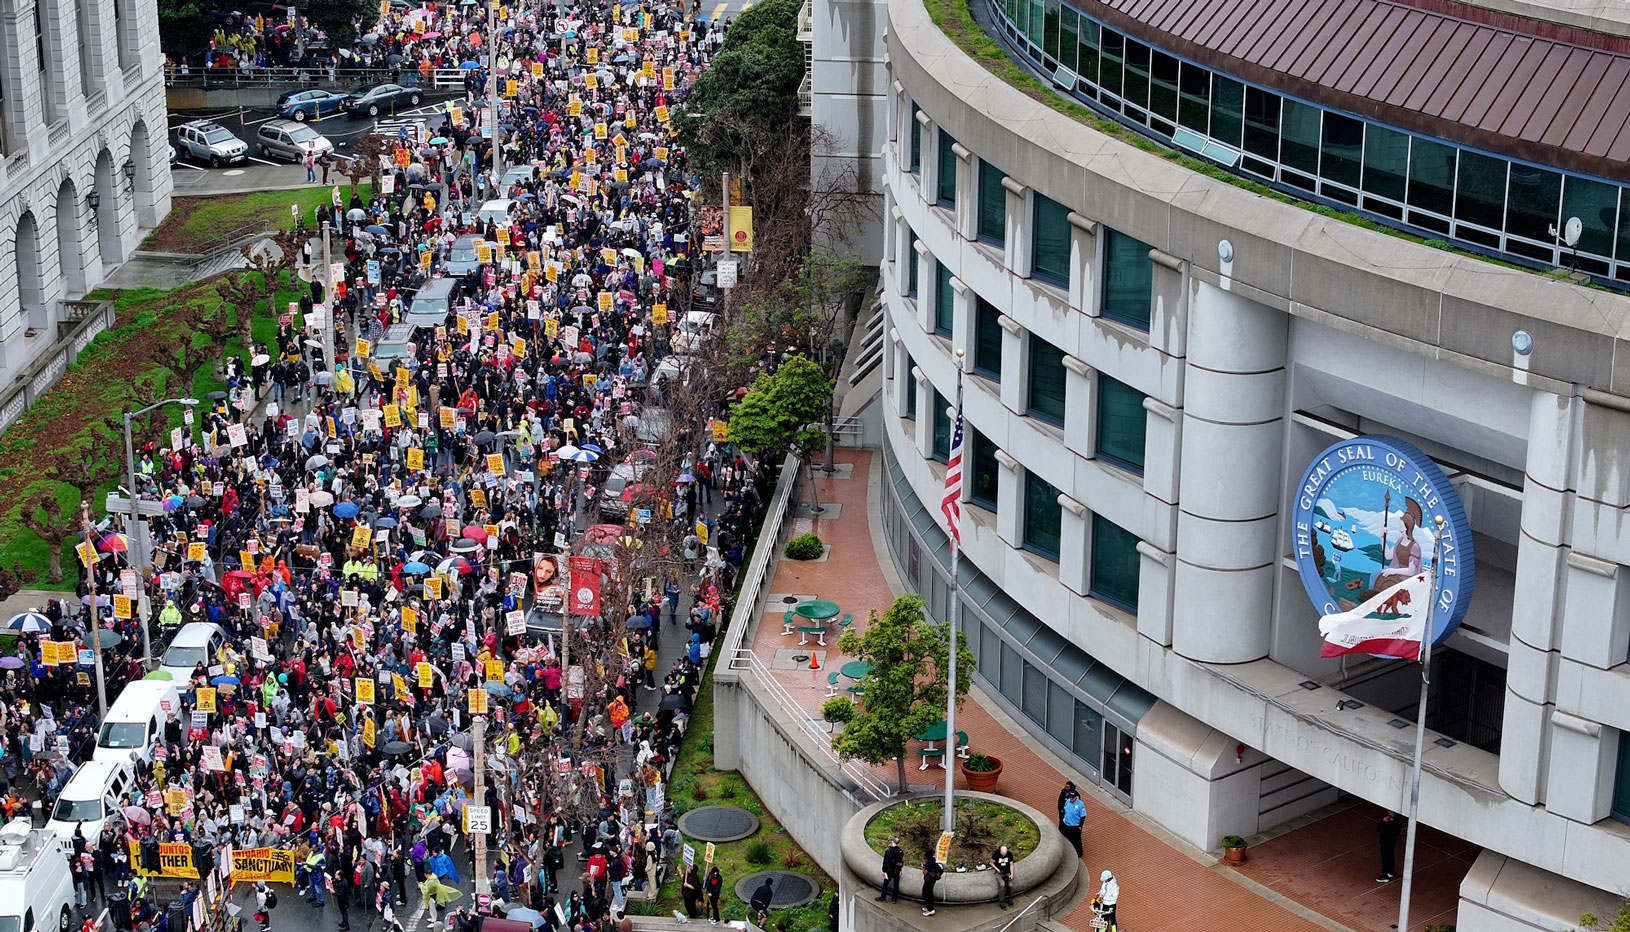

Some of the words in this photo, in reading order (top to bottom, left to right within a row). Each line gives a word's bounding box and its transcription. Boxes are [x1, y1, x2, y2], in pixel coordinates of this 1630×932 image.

[1338, 445, 1375, 464] SEAL
[1385, 452, 1406, 472] OF
[1300, 457, 1333, 511] GREAT
[1362, 470, 1403, 494] EUREKA
[1414, 471, 1438, 509] THE
[1297, 521, 1311, 559] THE
[1440, 519, 1456, 577] STATE
[1439, 588, 1454, 614] OF
[1297, 735, 1314, 752] O
[471, 821, 487, 830] 25
[160, 844, 190, 855] JUNTOS
[234, 858, 293, 873] SANCTUARY
